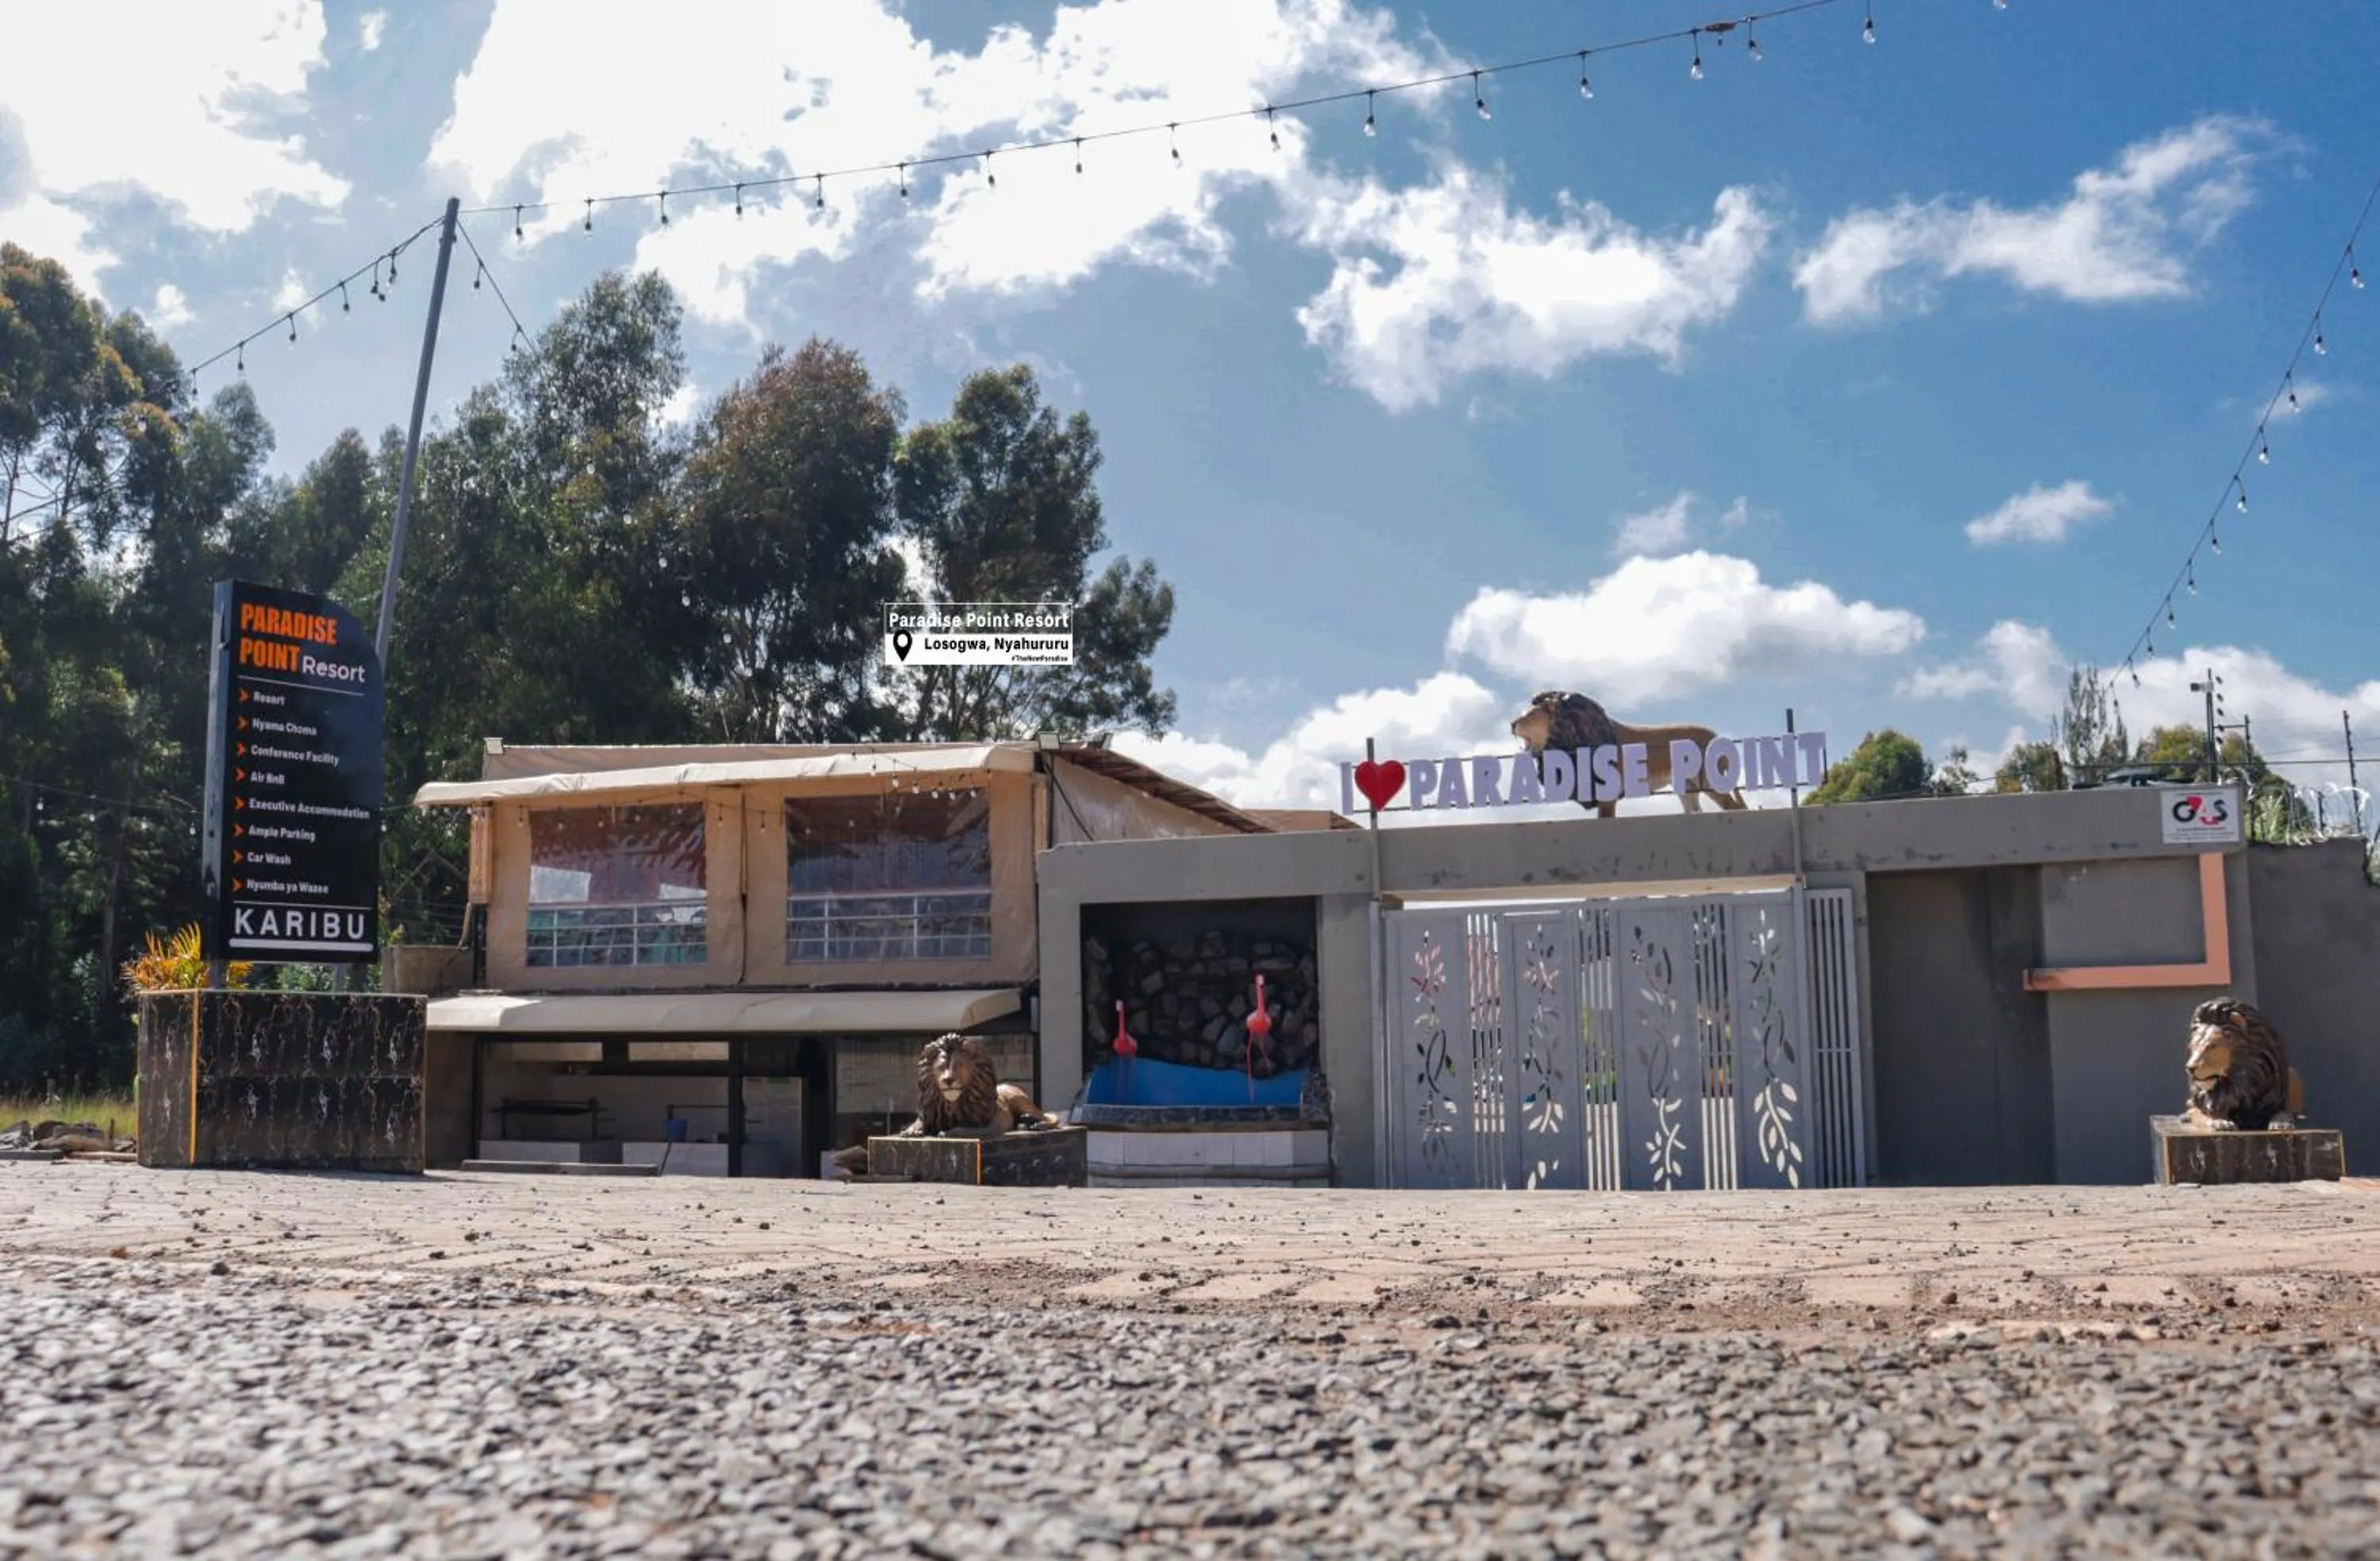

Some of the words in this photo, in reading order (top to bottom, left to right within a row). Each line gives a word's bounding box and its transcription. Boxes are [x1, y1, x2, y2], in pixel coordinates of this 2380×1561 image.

[240, 603, 338, 644] PARADISE
[240, 638, 300, 673] POINT
[302, 655, 366, 683] Resort
[253, 691, 285, 705] Resort
[251, 718, 285, 732] Nyama
[286, 723, 317, 736] Choma
[251, 745, 305, 760] Conference
[306, 751, 340, 767] Facility
[250, 772, 264, 782] Air
[1341, 761, 1353, 815] I
[1409, 742, 1650, 811] PARADISE
[1669, 731, 1826, 794] POINT
[248, 799, 297, 812] Executive
[298, 803, 370, 819] Accommodation
[2172, 796, 2228, 826] G4S
[248, 825, 279, 838] Ample
[280, 827, 316, 842] Parking
[247, 852, 264, 863] Car
[265, 853, 291, 865] Wash
[247, 879, 285, 892] Nyumba
[286, 883, 297, 894] ya
[298, 881, 329, 893] Wazee
[234, 907, 365, 940] KARIBU
